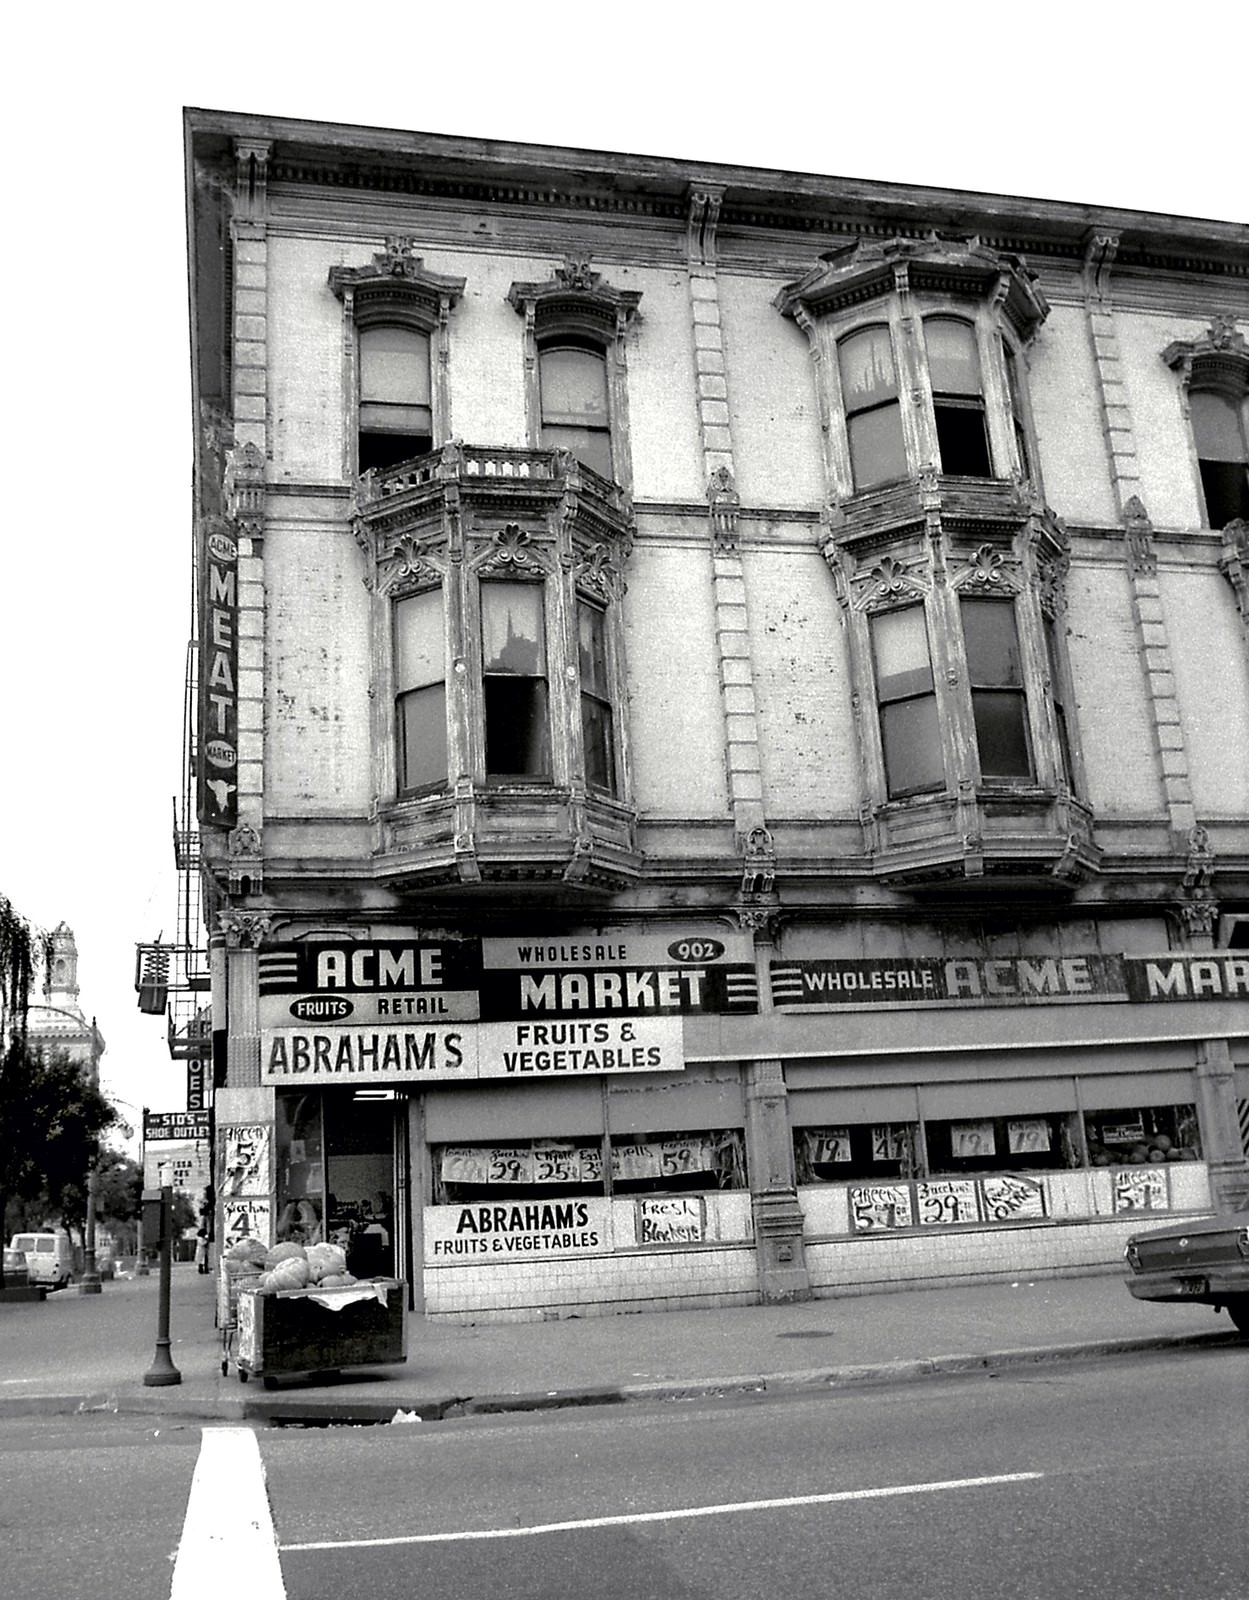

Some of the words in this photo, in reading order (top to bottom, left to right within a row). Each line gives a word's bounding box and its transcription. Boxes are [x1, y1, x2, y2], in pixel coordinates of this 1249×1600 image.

[210, 538, 236, 558] ACME
[209, 563, 234, 734] MEAT
[208, 744, 236, 763] MARKET
[517, 944, 627, 963] WHOLESALE
[678, 942, 715, 959] 902
[317, 949, 443, 988] ACME
[804, 968, 934, 992] WHOLESALE
[944, 958, 1089, 997] ACME
[520, 969, 706, 1010] MARKET
[296, 1001, 349, 1016] FRUITS
[377, 997, 449, 1015] RETAIL
[516, 1023, 610, 1046] FRUITS
[619, 1022, 637, 1042] &
[503, 1047, 661, 1072] VEGETABLES
[145, 1127, 171, 1139] SHOE
[490, 1160, 520, 1181] 29
[538, 1162, 569, 1180] 25
[663, 1149, 691, 1174] 59
[456, 1202, 589, 1234] ABRAHAM'S
[924, 1195, 960, 1223] 29
[434, 1238, 488, 1255] FRUITS
[504, 1231, 599, 1251] VEGETABLES
